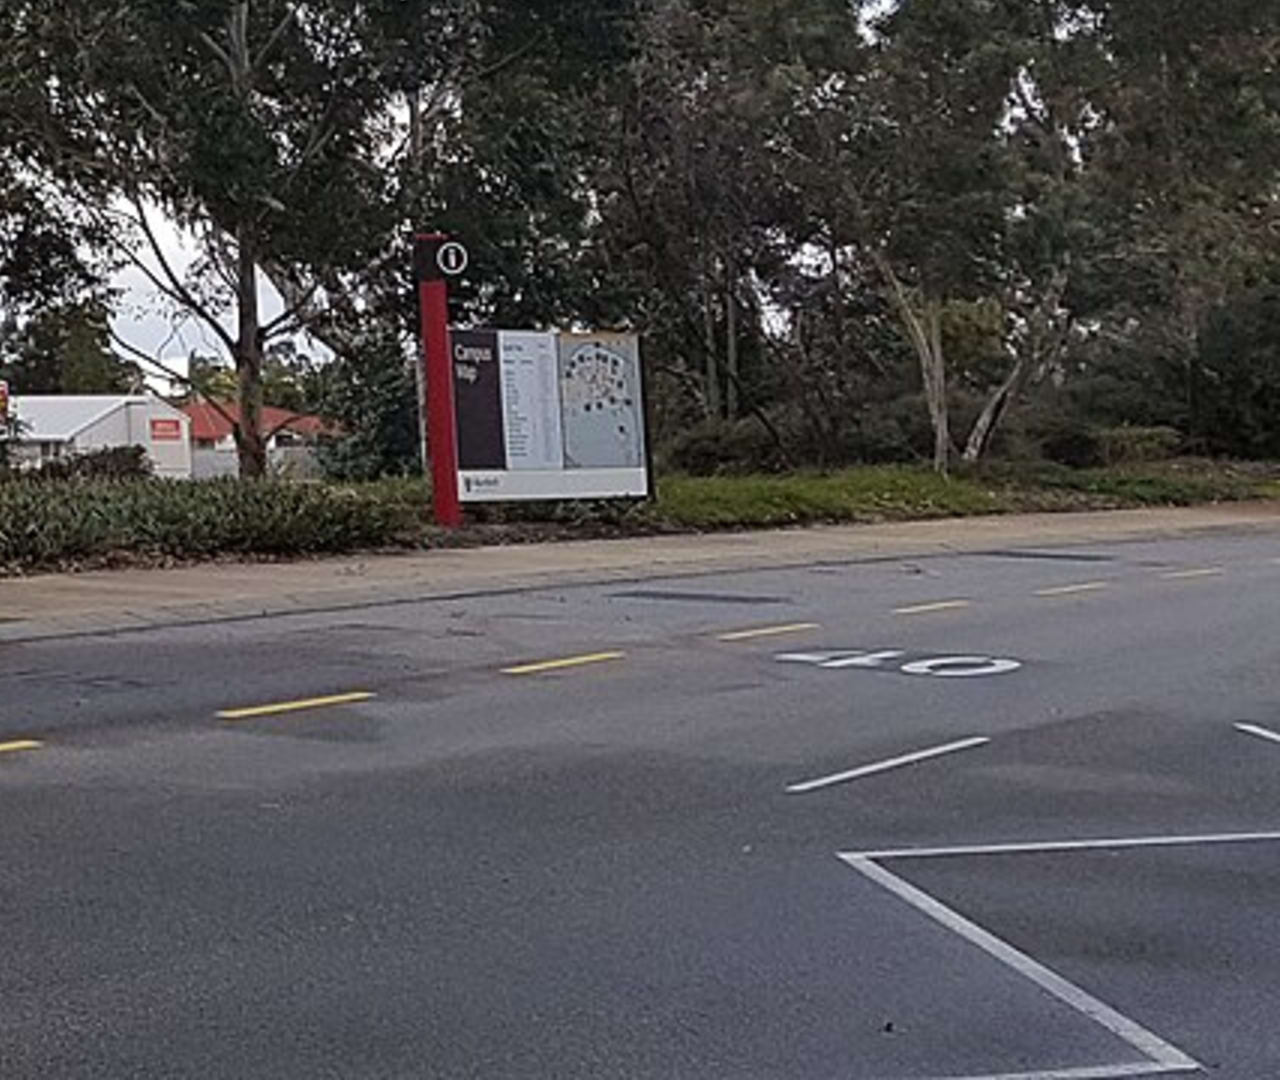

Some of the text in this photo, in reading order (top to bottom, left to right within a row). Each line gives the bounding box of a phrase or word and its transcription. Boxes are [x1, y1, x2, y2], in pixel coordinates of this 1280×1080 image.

[454, 344, 493, 364] Campus
[455, 362, 478, 384] Map
[773, 649, 1022, 677] 40
